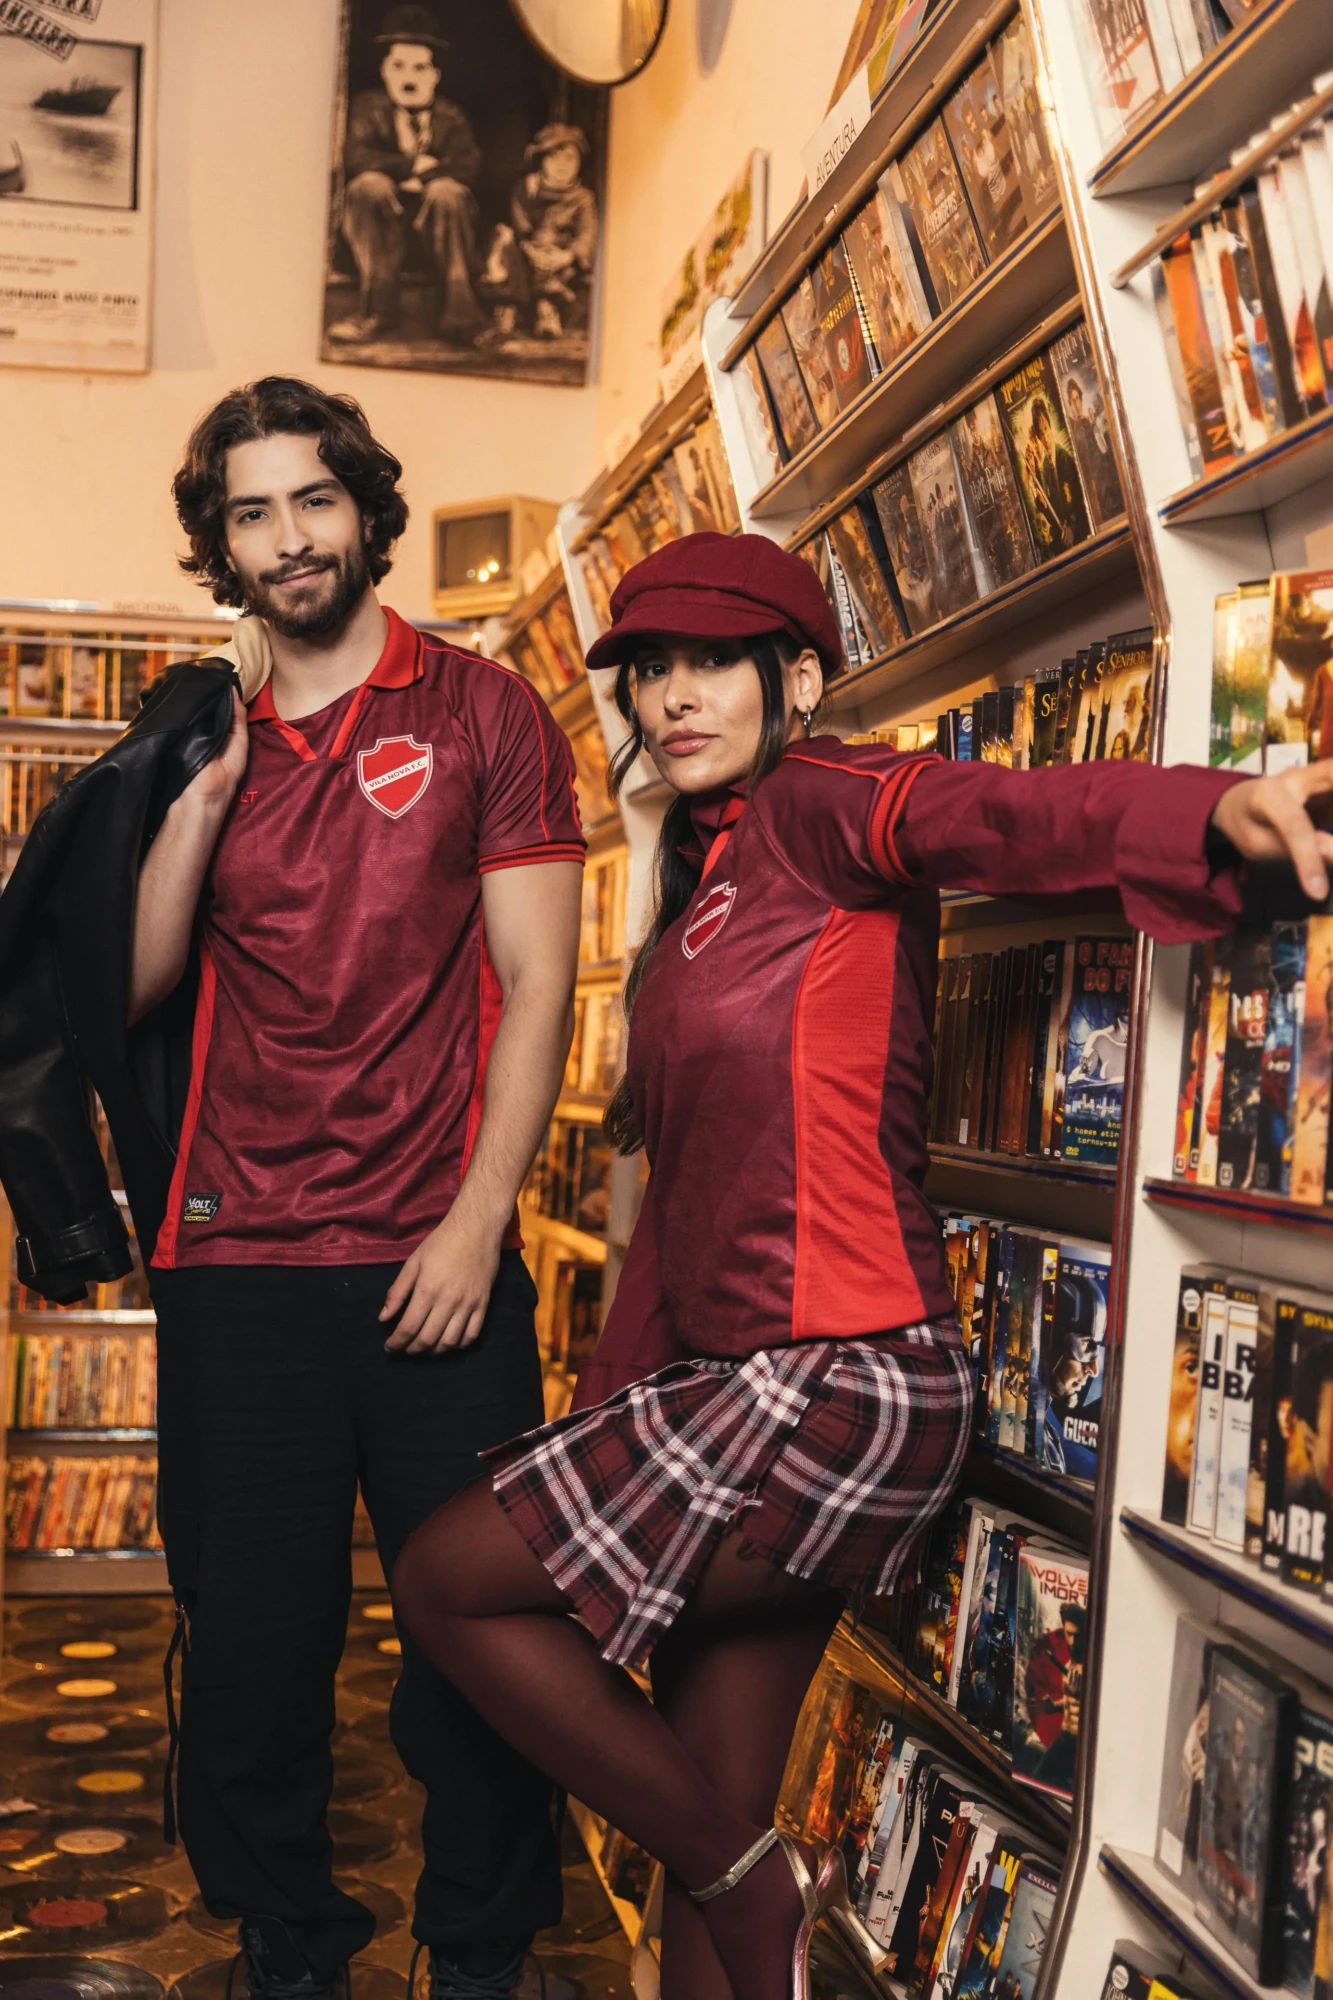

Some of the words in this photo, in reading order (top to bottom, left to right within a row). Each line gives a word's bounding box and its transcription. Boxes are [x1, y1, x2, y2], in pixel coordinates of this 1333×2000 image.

[817, 117, 857, 188] AVENTURA
[1107, 651, 1147, 675] SENHOR
[369, 777, 387, 788] VILA
[387, 766, 411, 780] NOVA
[1084, 967, 1110, 992] DO
[1074, 1127, 1097, 1136] homem
[188, 1197, 211, 1209] VOLT
